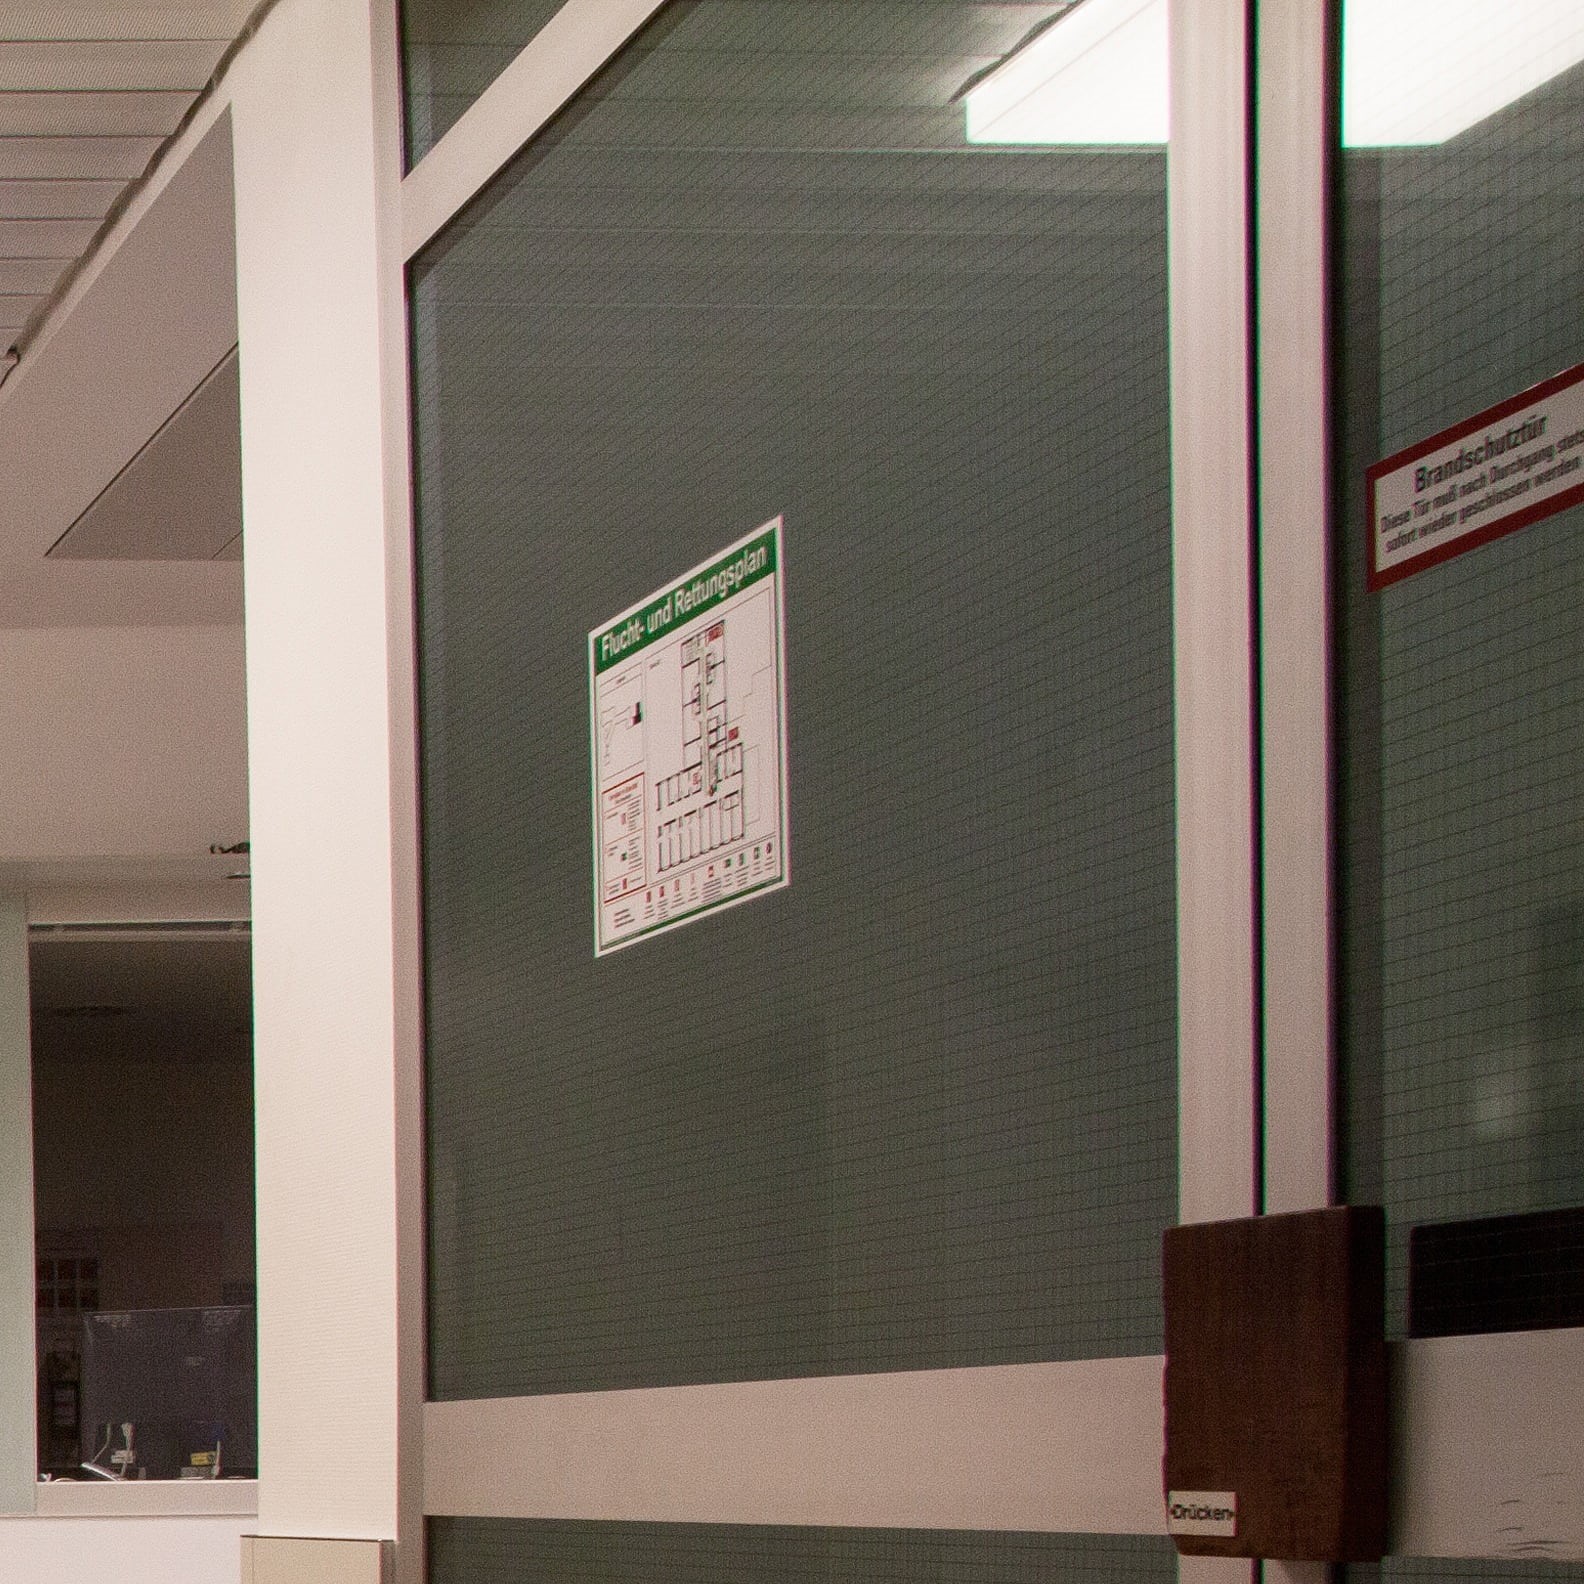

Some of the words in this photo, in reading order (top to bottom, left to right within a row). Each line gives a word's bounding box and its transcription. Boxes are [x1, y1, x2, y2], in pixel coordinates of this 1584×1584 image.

[1413, 414, 1547, 493] Brandschutztür
[1489, 445, 1554, 484] Durchgang
[601, 618, 645, 661] Flucht-
[647, 594, 673, 634] und
[675, 546, 768, 617] Rettungsplan
